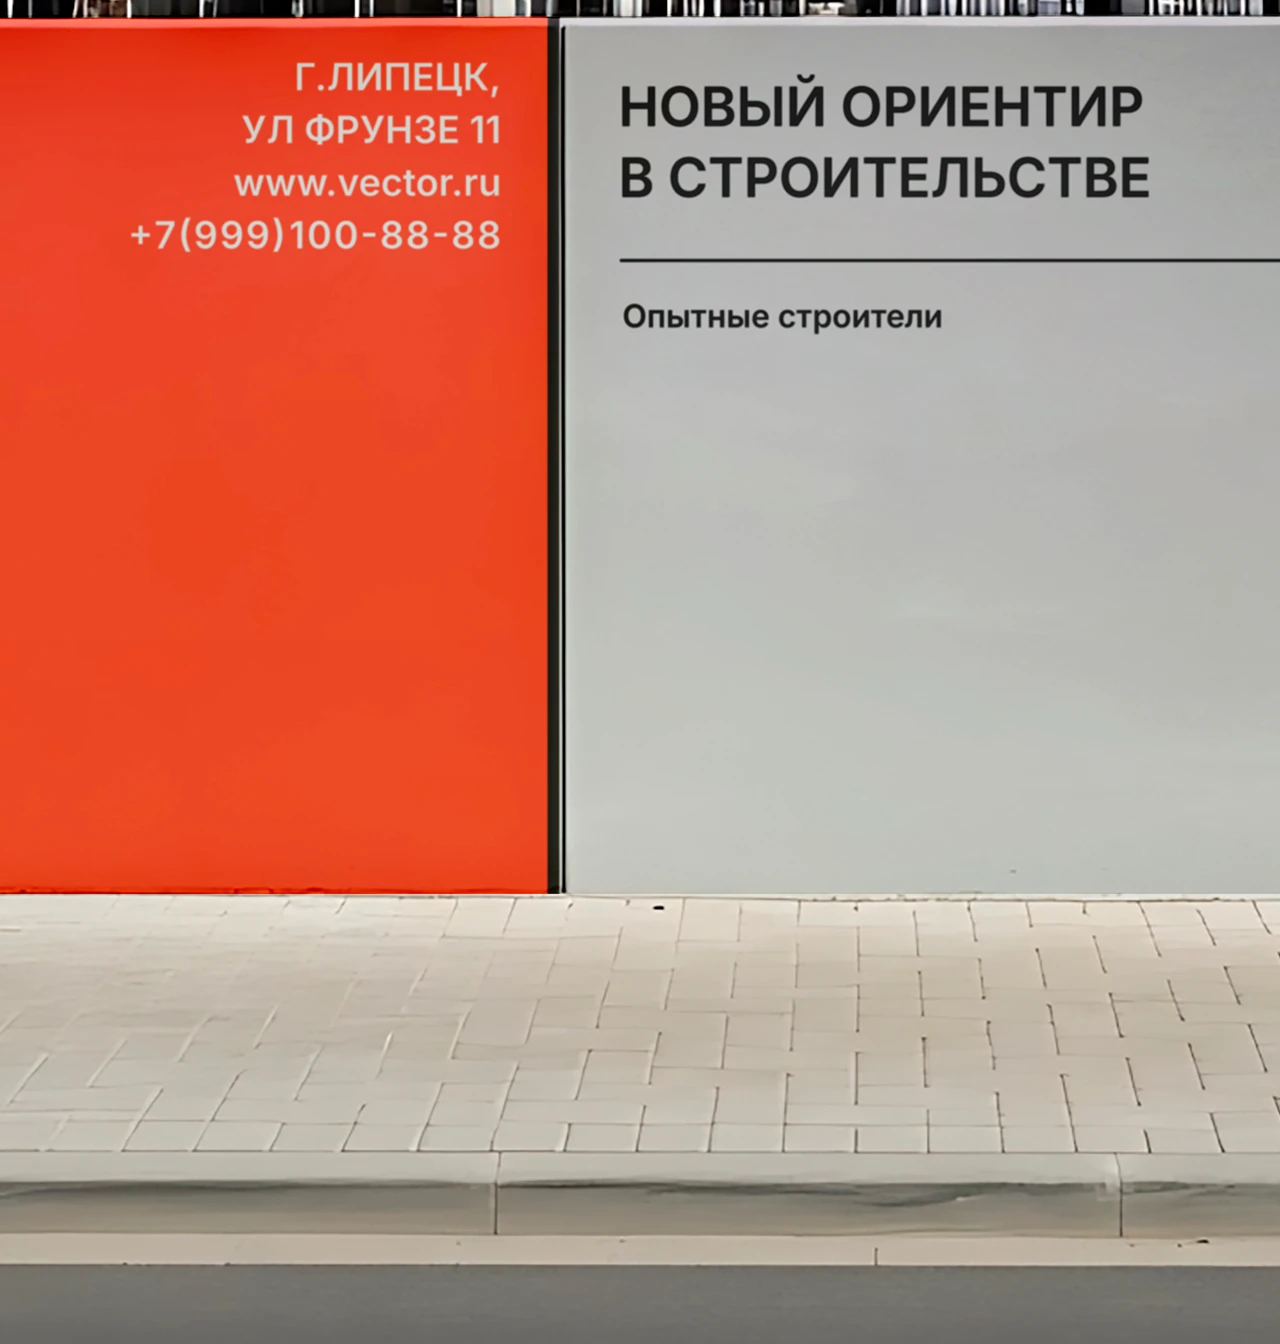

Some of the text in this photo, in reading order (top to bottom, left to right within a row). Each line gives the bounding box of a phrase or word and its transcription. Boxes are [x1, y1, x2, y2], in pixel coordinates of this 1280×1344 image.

[295, 61, 500, 99] Г.ЛИПЕЦК,
[620, 73, 1144, 128] НОВЫЙ ОРИЕНТИР
[241, 113, 500, 146] УЛ ФРУНЗЕ 11
[233, 168, 501, 197] www.vector.ru
[620, 155, 1151, 199] В СТРОИТЕЛЬСТВЕ
[130, 216, 501, 253] +7(999)100-88-88
[622, 302, 943, 335] Опытные строители
